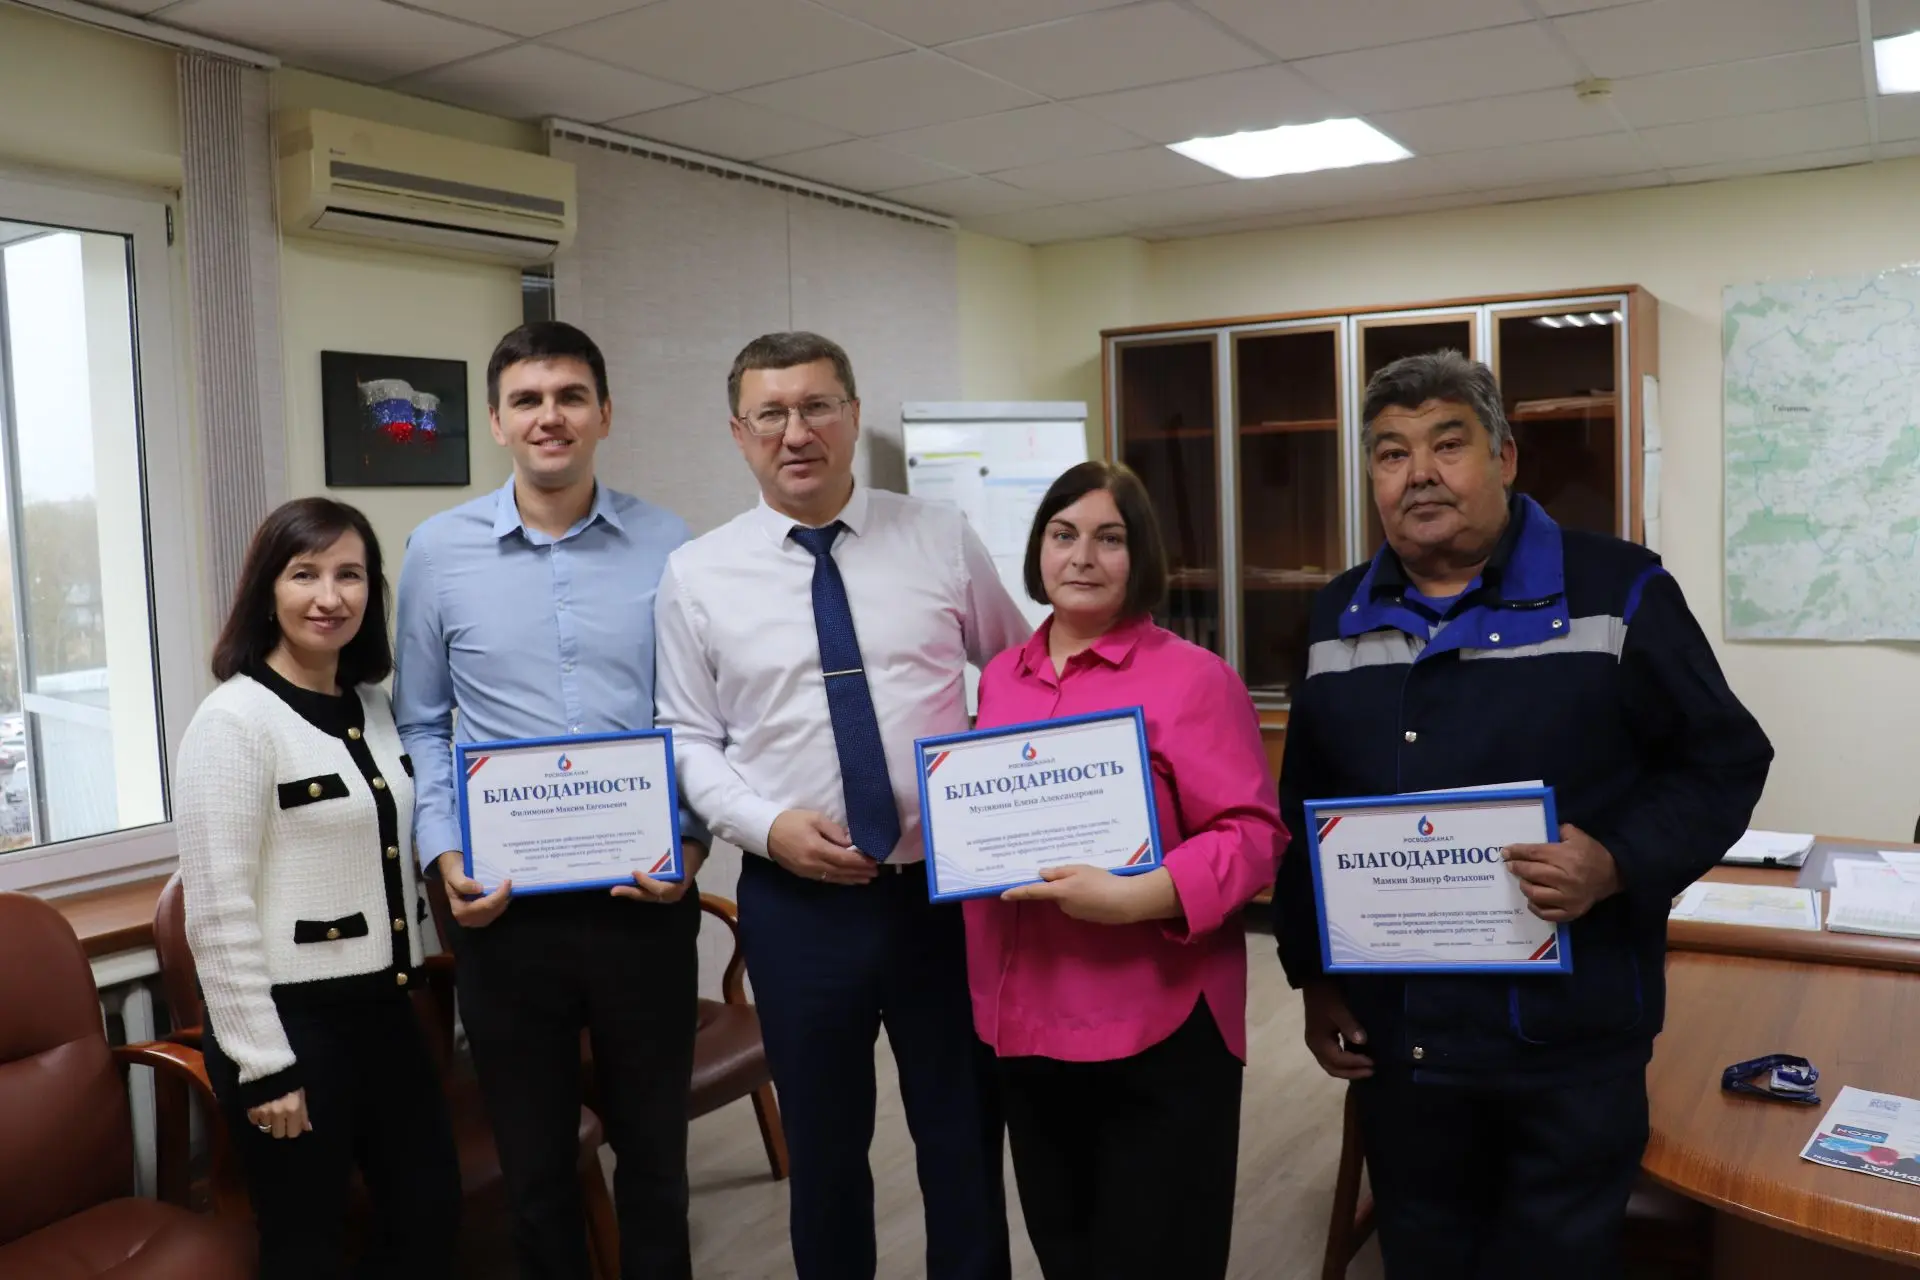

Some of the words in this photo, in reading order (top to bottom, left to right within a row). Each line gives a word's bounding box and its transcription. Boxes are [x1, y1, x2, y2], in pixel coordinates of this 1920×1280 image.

[945, 760, 1124, 800] БЛАГОДАРНОСТЬ
[483, 776, 651, 804] БЛАГОДАРНОСТЬ
[1014, 796, 1038, 808] Елена
[1039, 787, 1104, 806] Александровна
[510, 807, 554, 818] Филимонов
[555, 804, 584, 814] Максим
[585, 800, 627, 812] Евгеньевич
[1403, 835, 1455, 844] РОСВОДОКАНАЛ
[1337, 846, 1504, 871] БЛАГОДАРНОС
[1372, 876, 1408, 886] Мамкин
[1409, 875, 1442, 887] Зиннур
[1443, 873, 1495, 884] Фатыхович
[1836, 1128, 1883, 1140] OZON
[1812, 1154, 1848, 1166] OZON
